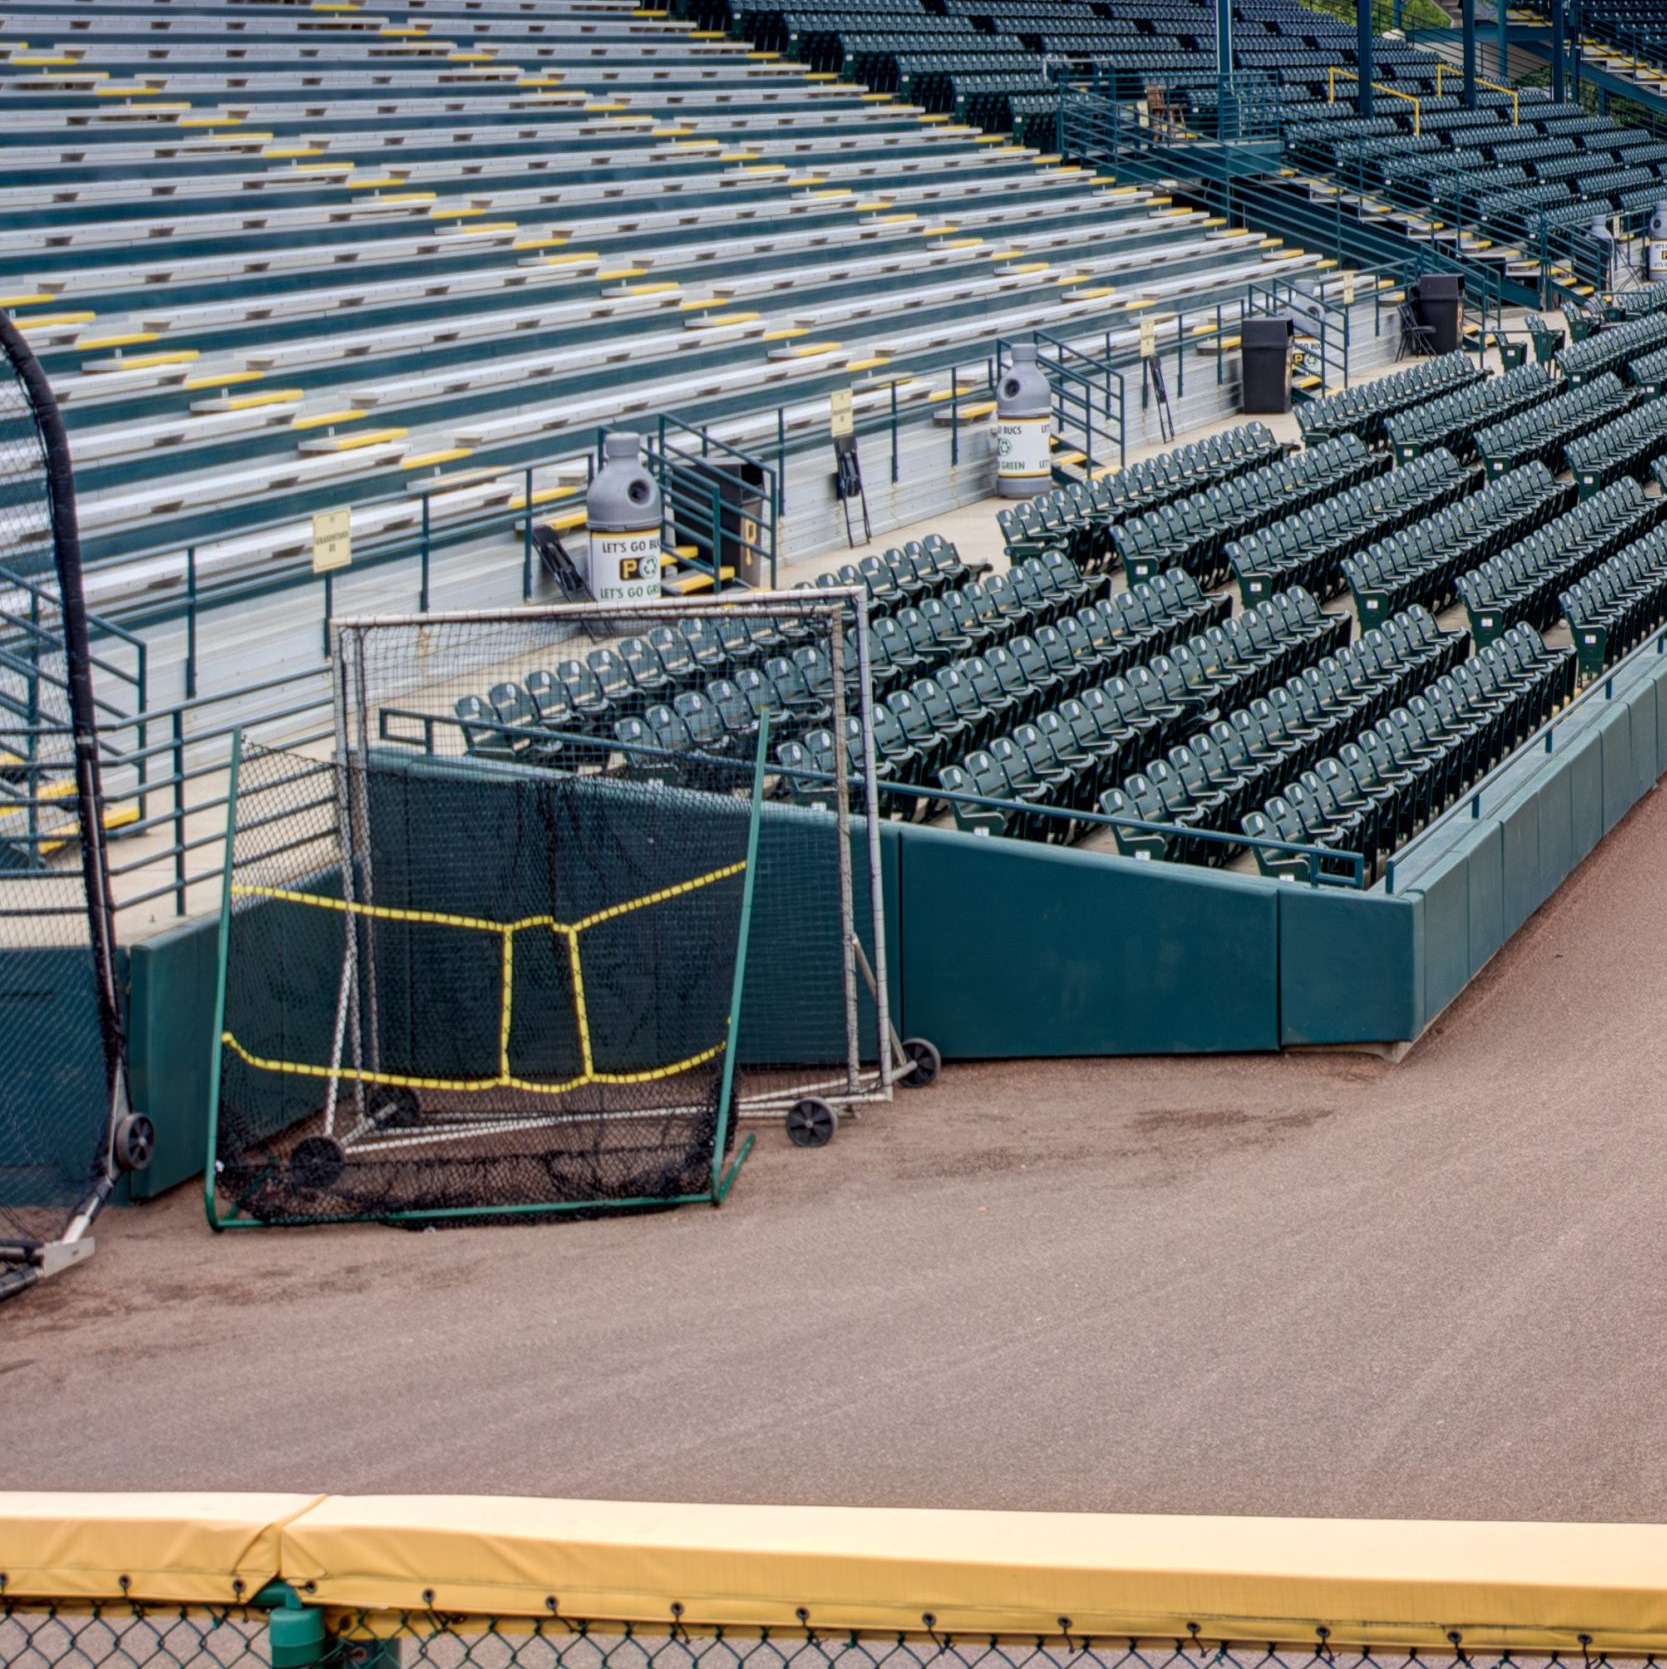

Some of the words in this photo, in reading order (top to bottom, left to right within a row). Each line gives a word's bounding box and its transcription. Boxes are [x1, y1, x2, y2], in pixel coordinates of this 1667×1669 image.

[1003, 426, 1022, 434] BUCS
[1002, 461, 1025, 470] GREEN
[602, 542, 627, 553] LET'S
[630, 541, 646, 552] GO
[600, 587, 624, 599] LET'S
[628, 586, 643, 598] GO
